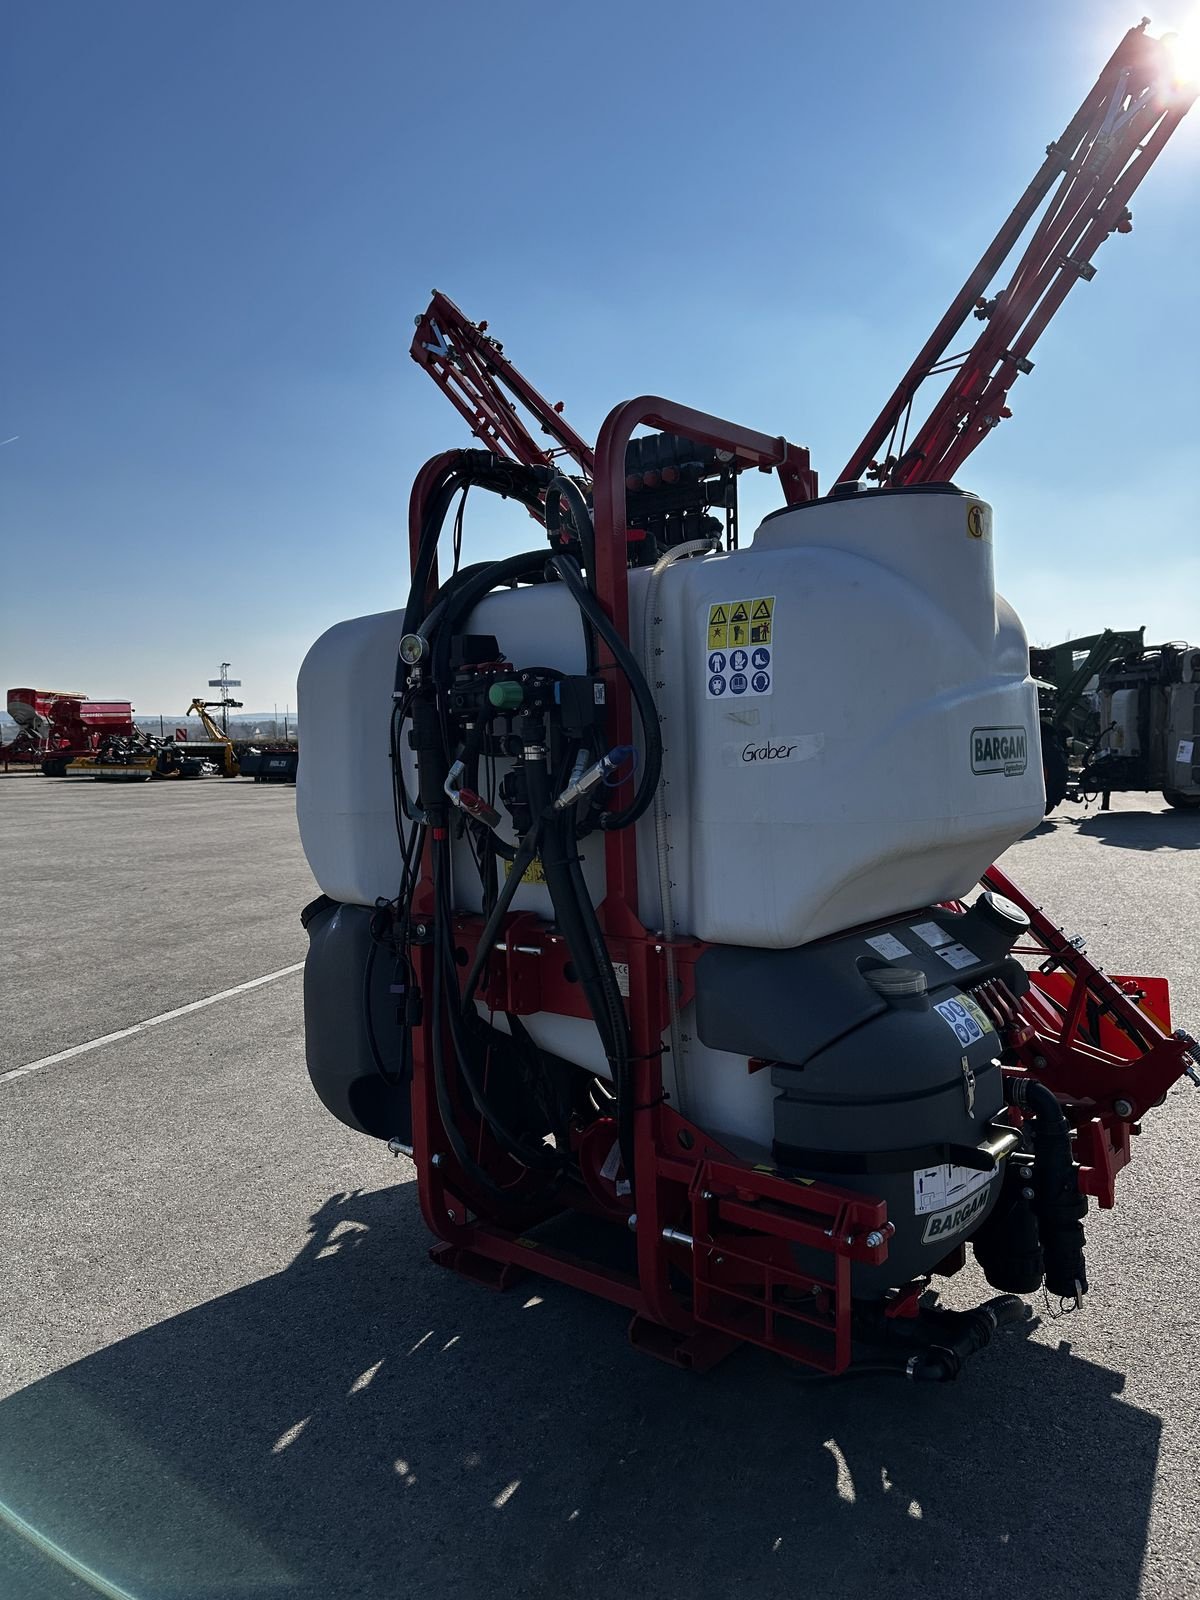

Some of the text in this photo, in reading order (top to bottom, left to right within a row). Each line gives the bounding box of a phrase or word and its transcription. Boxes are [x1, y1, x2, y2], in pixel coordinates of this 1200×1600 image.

[742, 740, 798, 762] Graber
[975, 736, 1025, 762] BARGAM
[927, 1188, 990, 1237] BARGAM
